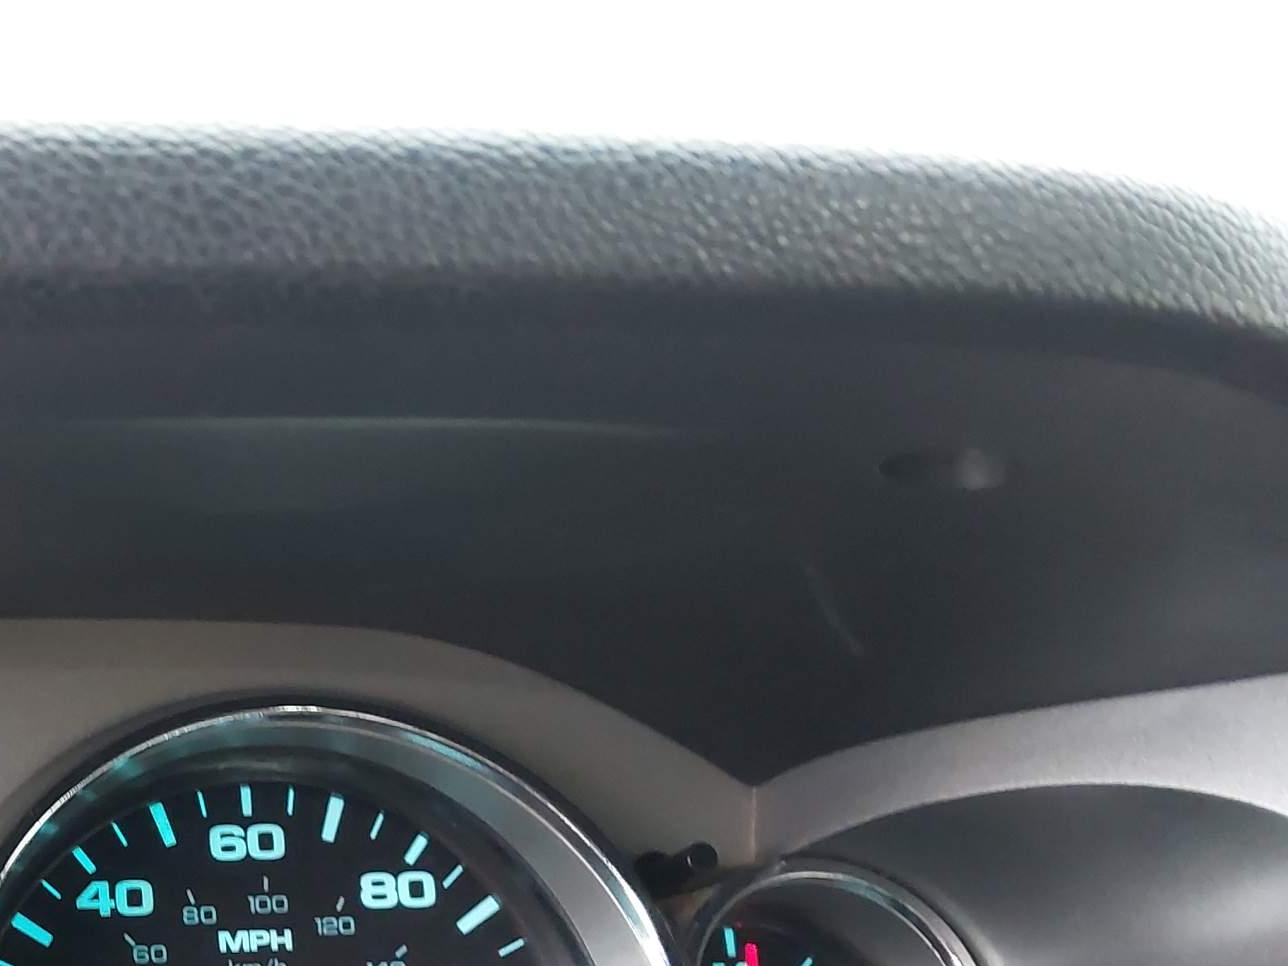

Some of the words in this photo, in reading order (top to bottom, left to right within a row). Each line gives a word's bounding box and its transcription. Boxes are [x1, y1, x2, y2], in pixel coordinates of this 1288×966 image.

[208, 824, 286, 861] 60
[75, 880, 155, 918] 40
[359, 871, 437, 909] 80
[182, 905, 217, 926] 80
[248, 894, 288, 914] 100
[314, 915, 356, 936] 120
[218, 929, 294, 954] MPH
[133, 944, 168, 965] 60
